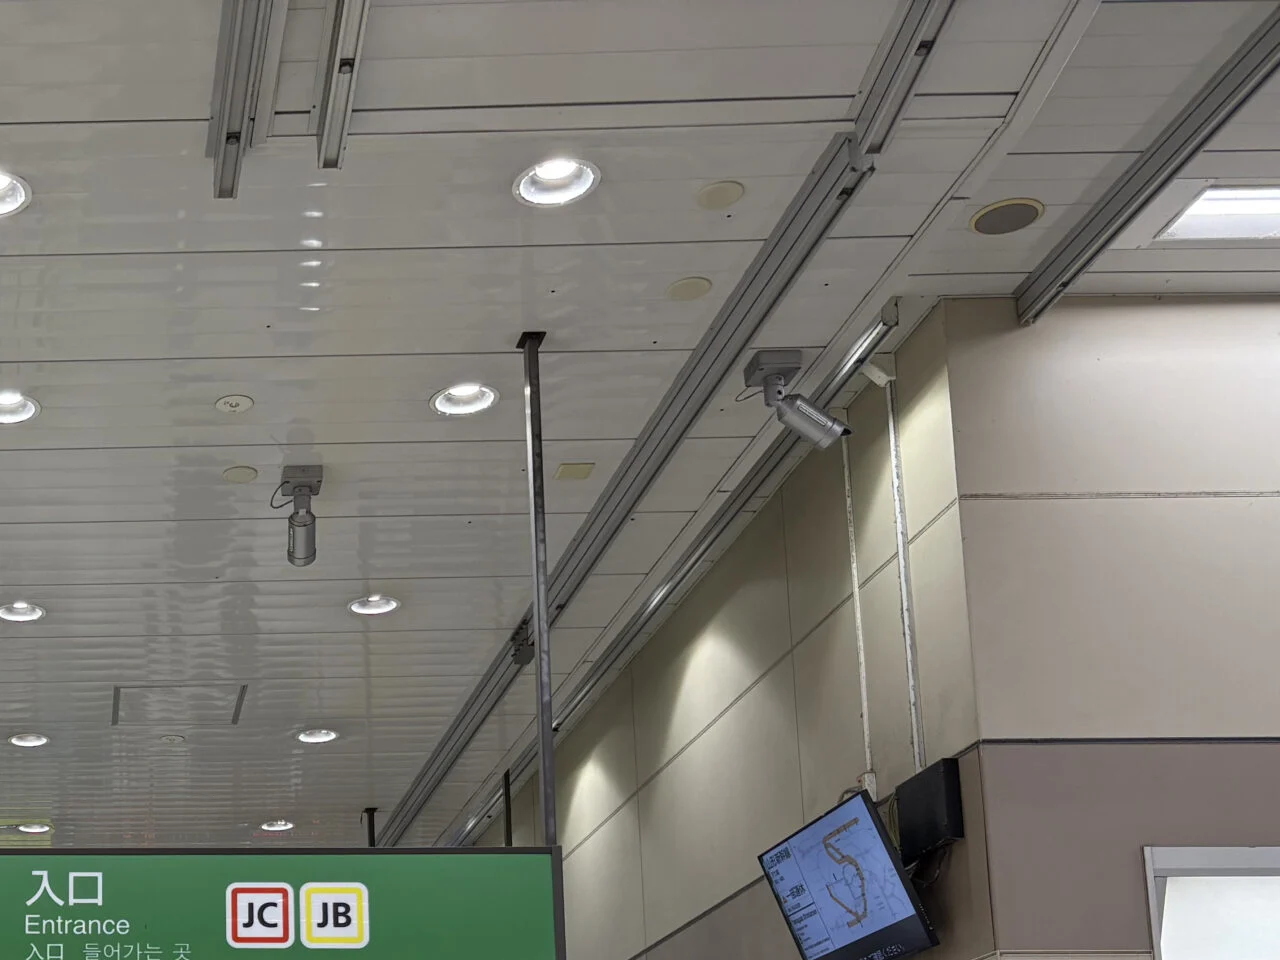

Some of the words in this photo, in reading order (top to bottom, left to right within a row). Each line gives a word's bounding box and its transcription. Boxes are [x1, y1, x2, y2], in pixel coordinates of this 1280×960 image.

[25, 869, 104, 907] 入口
[24, 914, 131, 936] Entrance
[242, 902, 279, 929] JC
[316, 902, 353, 929] JB
[25, 943, 64, 960] 入口
